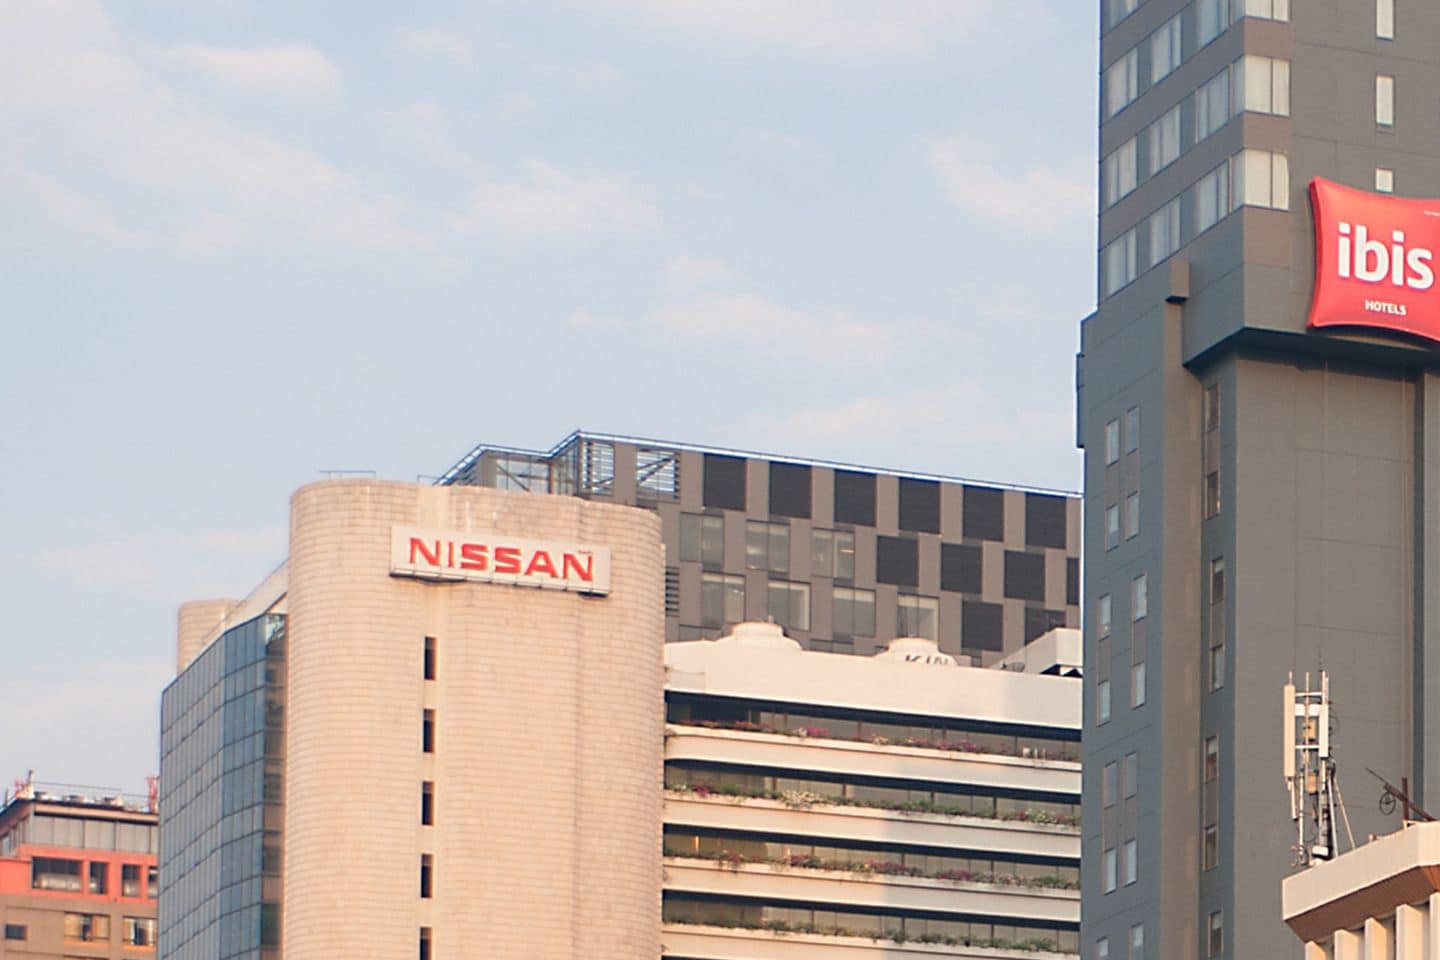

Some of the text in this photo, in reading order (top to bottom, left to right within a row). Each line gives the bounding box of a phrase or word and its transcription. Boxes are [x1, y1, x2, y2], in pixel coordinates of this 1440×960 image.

[1338, 221, 1434, 290] ibis
[1364, 299, 1407, 316] HOTELS
[409, 537, 594, 582] NISSAN
